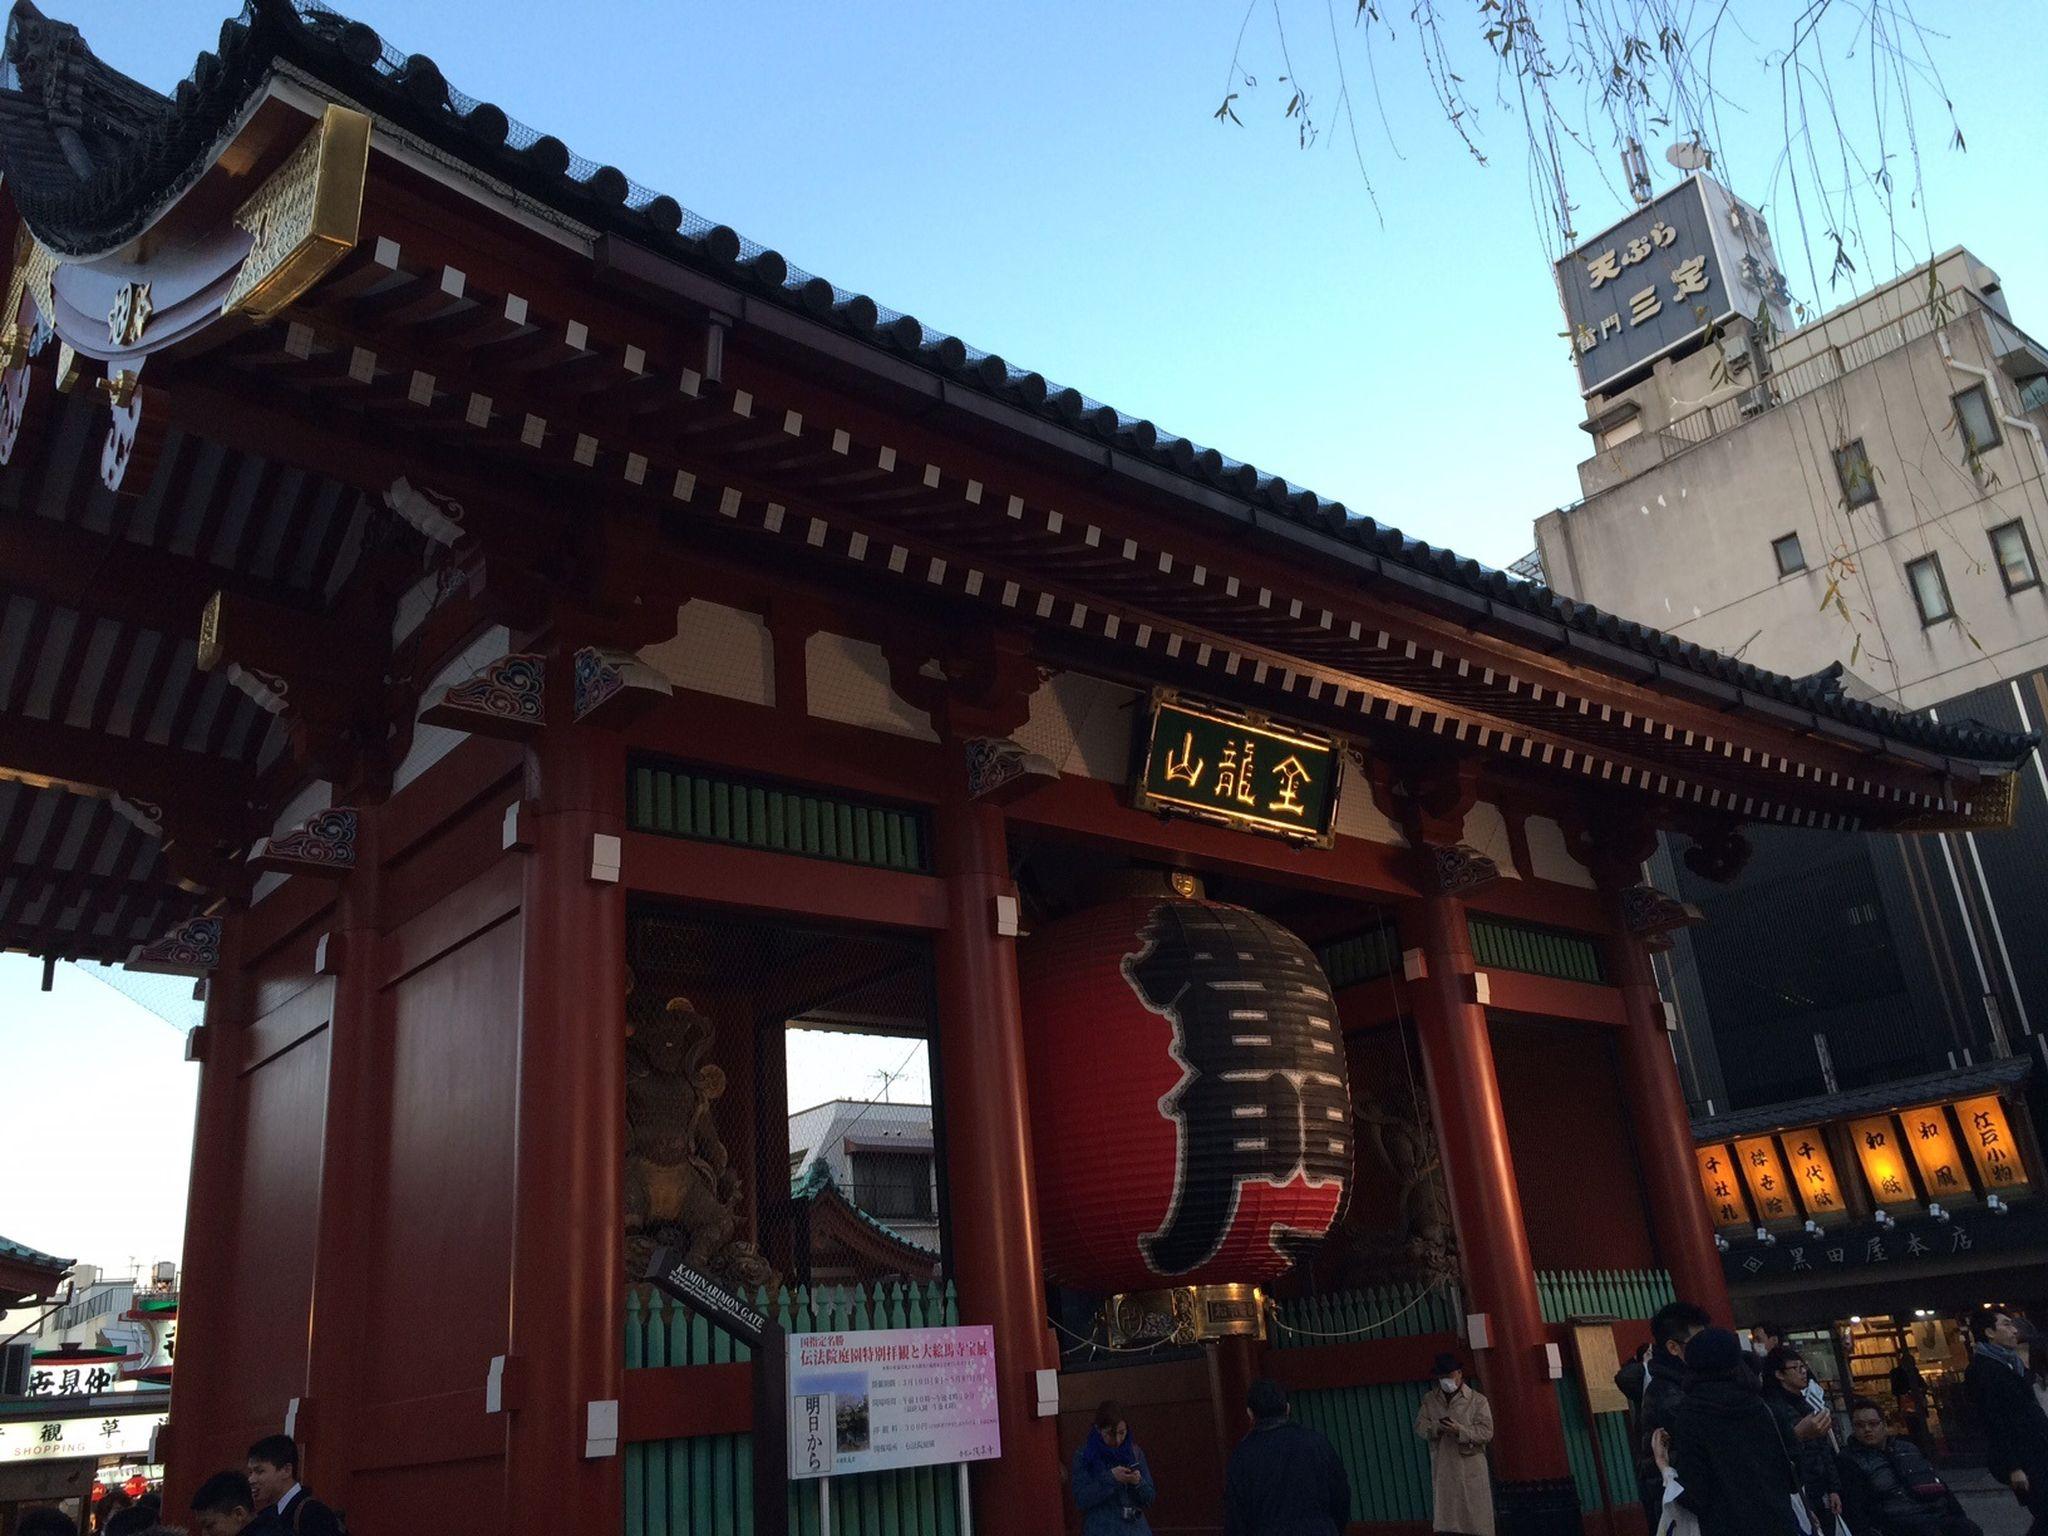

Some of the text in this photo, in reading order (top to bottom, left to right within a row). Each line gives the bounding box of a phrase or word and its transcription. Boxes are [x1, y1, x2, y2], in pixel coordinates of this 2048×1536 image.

[1789, 1226, 1974, 1272] 黒田屋本店
[676, 1264, 742, 1311] KAMINARIMON
[740, 1306, 765, 1329] GATE
[14, 1443, 86, 1457] SHOPPING
[806, 1396, 823, 1472] 明日から
